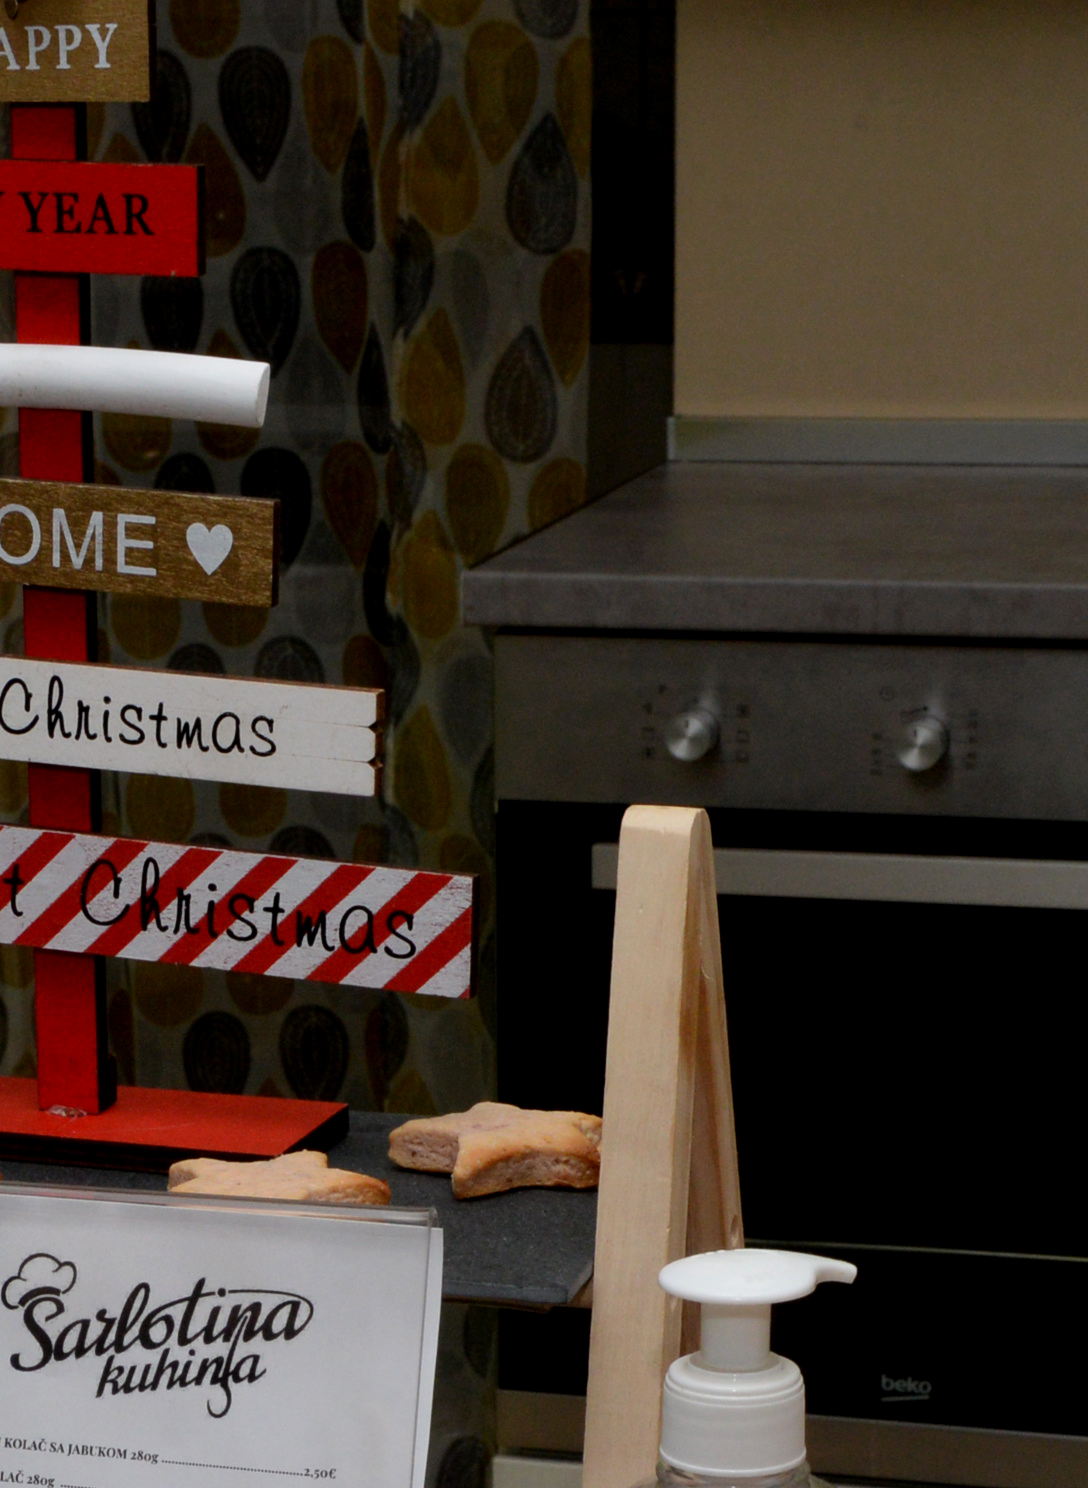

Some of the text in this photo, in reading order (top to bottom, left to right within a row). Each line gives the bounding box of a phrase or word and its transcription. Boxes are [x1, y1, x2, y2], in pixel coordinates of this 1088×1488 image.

[18, 191, 155, 236] YEAR
[79, 858, 417, 959] Christmas
[96, 1348, 266, 1418] kuhinja
[880, 1373, 933, 1394] beko
[3, 1437, 47, 1452] KOLAČ
[48, 1441, 65, 1454] SA
[66, 1443, 128, 1460] JABUKOM
[130, 1450, 160, 1465] 280g
[26, 1474, 56, 1488] 280g
